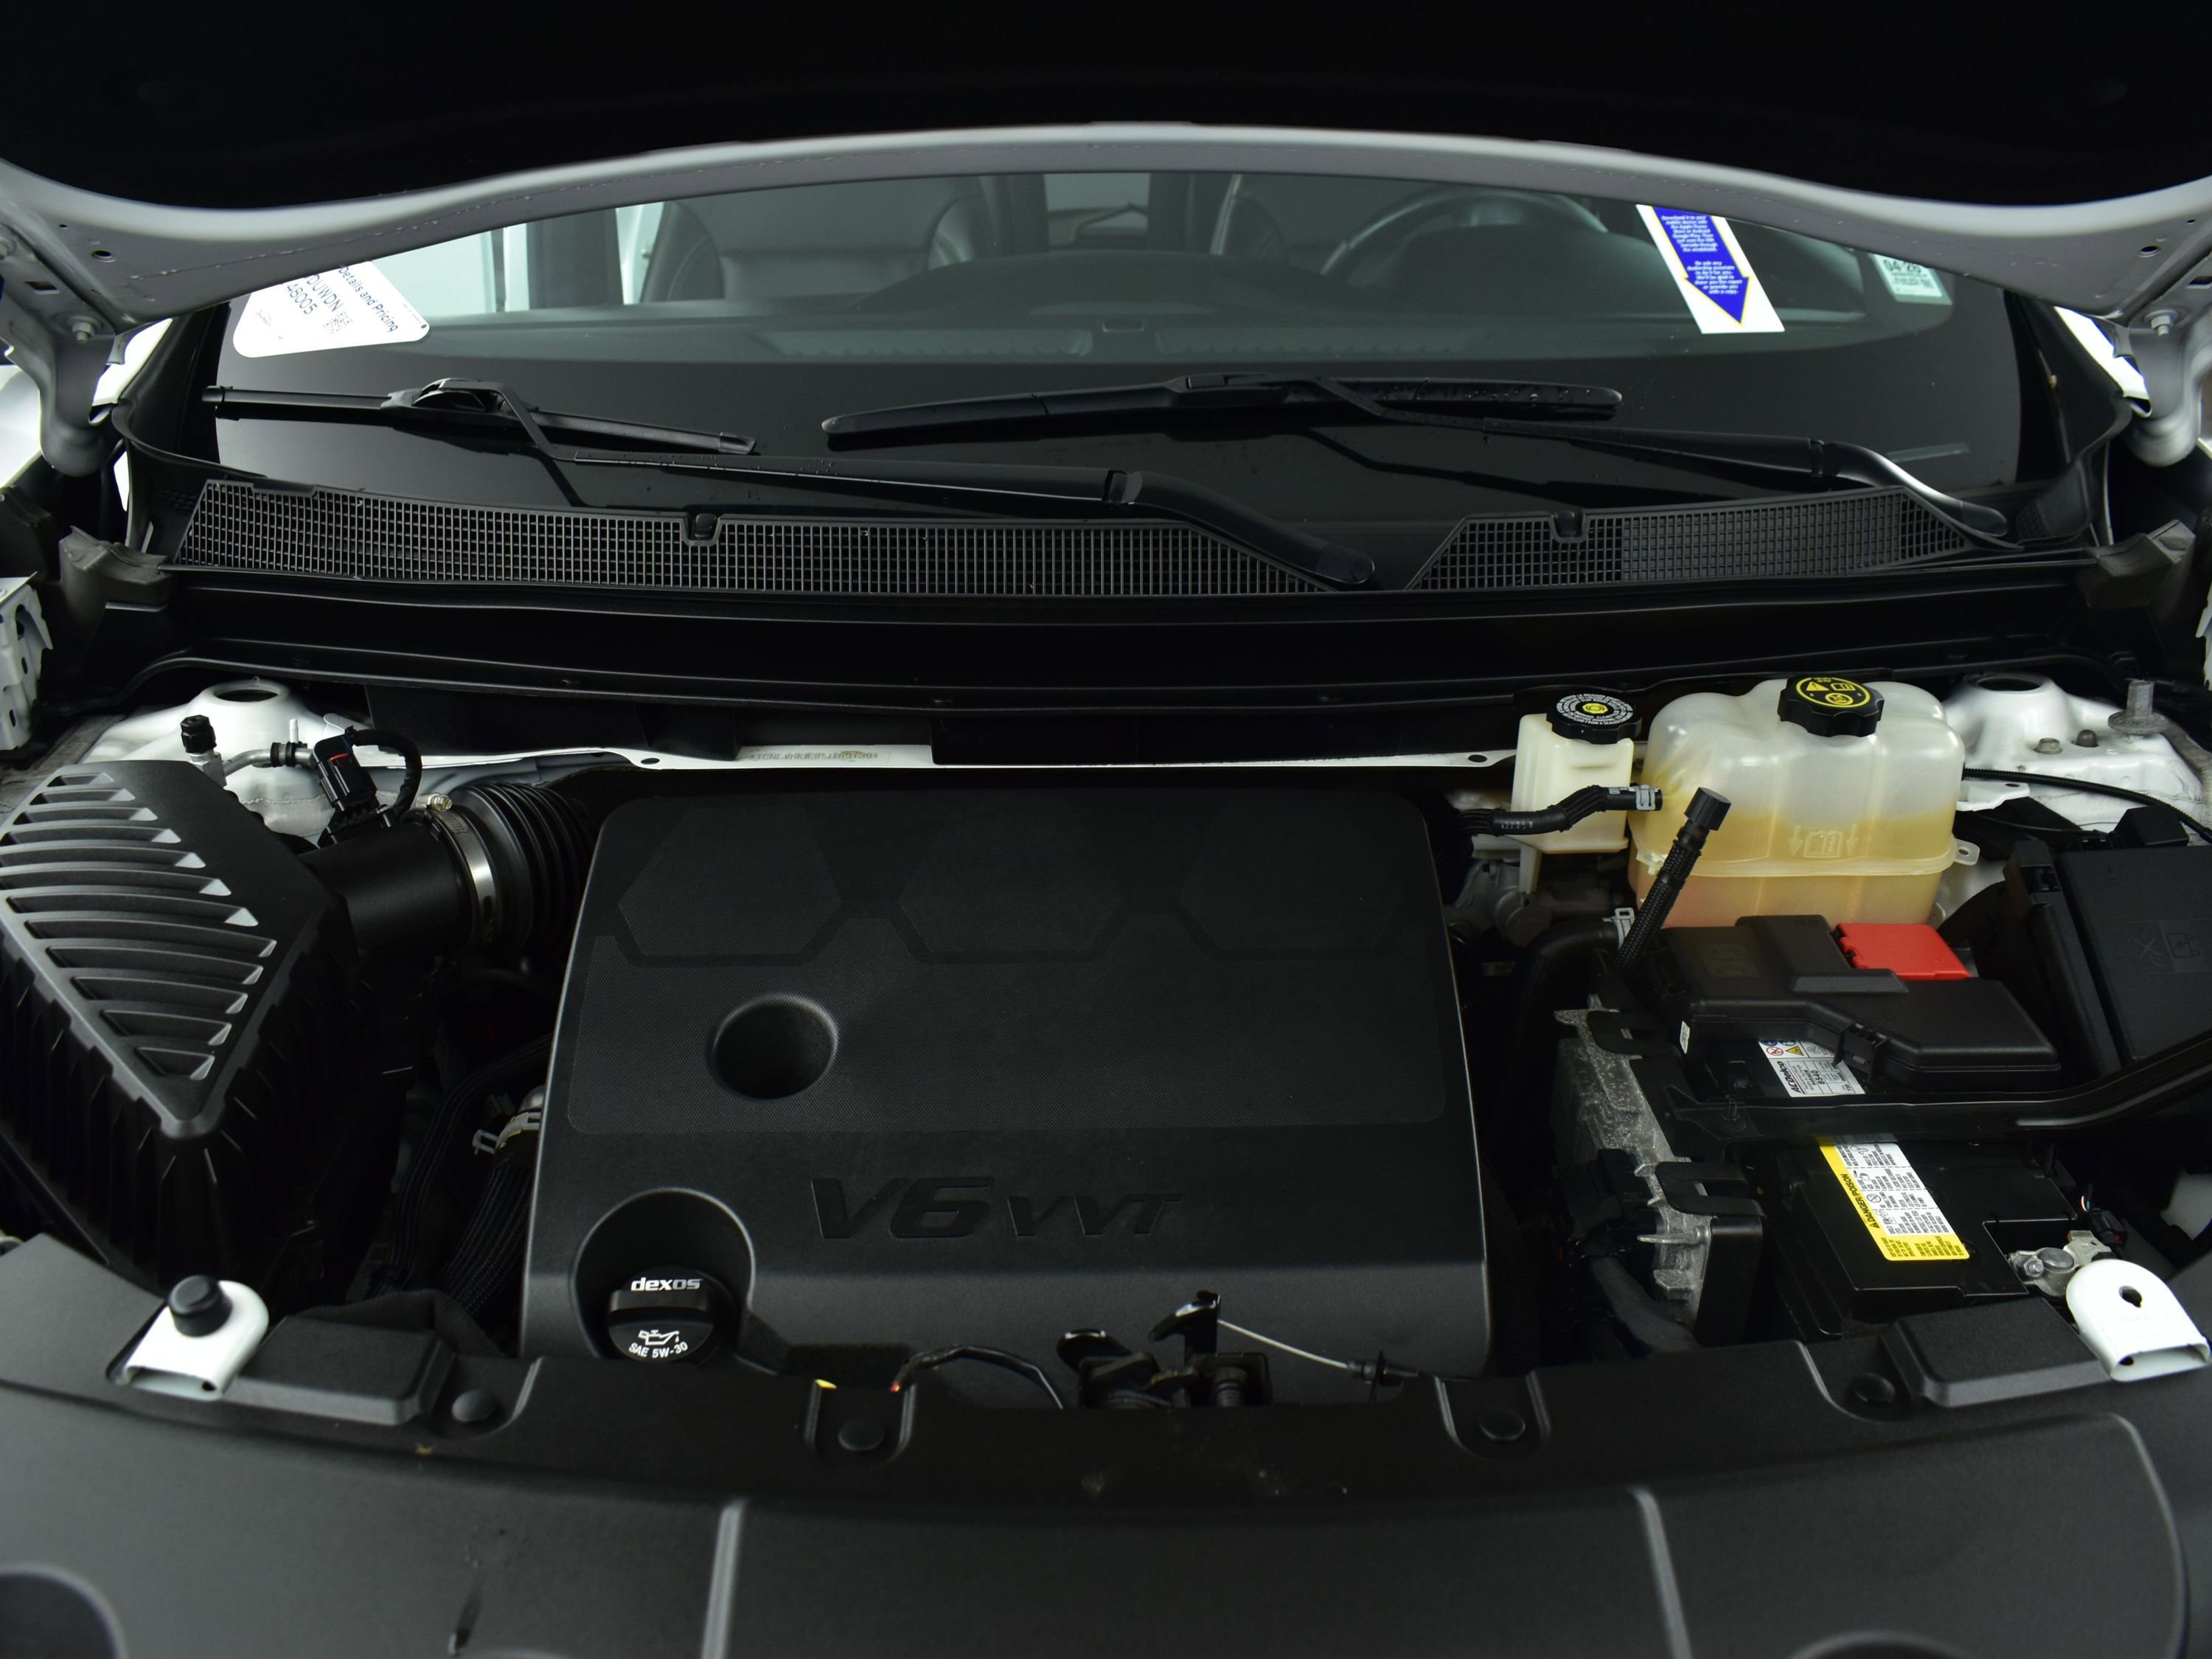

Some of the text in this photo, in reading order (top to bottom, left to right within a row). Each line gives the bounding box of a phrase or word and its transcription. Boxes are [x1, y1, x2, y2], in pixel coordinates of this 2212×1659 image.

[287, 283, 318, 315] 48005
[338, 266, 398, 333] Details and Pricing
[1777, 1061, 1801, 1093] ACDelco
[1809, 1070, 1826, 1084] 8540
[810, 1176, 1184, 1239] V6 VVT
[1840, 1173, 1876, 1222] DANGER/POISON
[631, 1277, 701, 1291] dexos
[629, 1341, 688, 1358] SAE 5W-30
